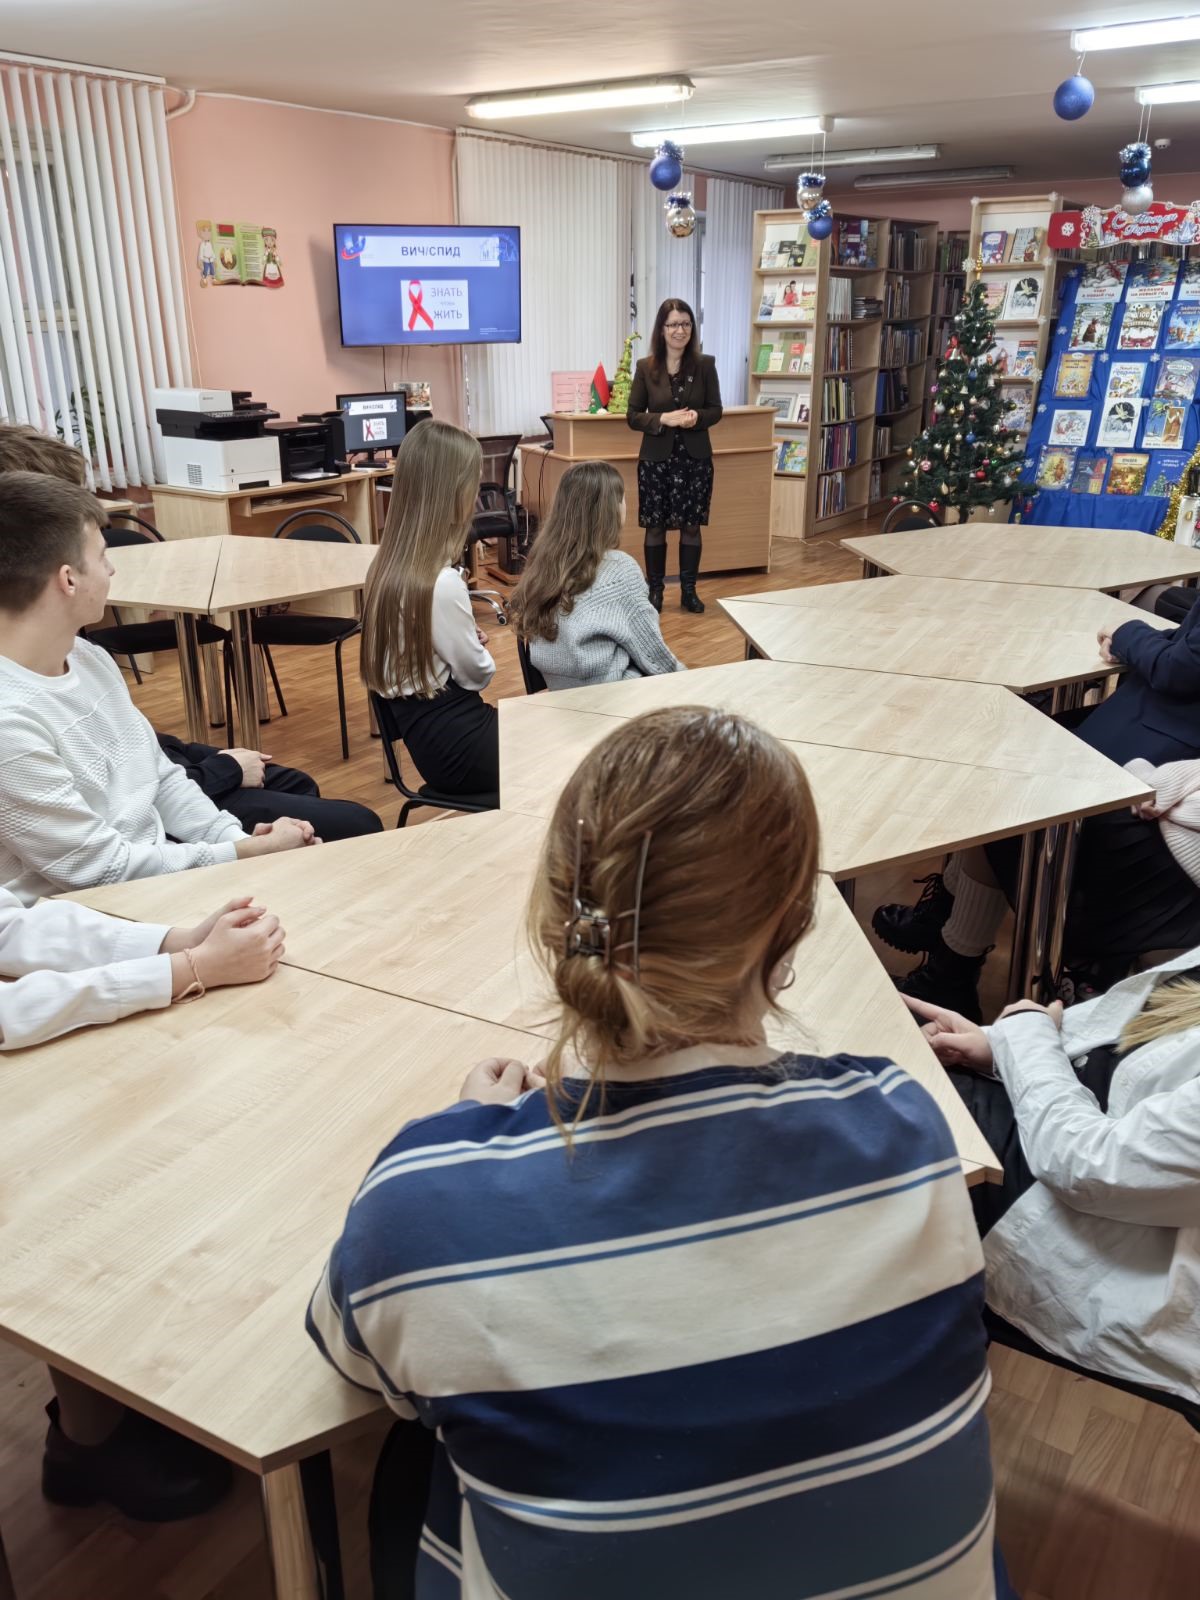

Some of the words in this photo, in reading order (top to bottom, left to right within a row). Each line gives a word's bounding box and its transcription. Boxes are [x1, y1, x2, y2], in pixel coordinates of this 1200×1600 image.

[401, 246, 461, 258] ВИЧ/СПИД
[430, 287, 463, 297] ЗНАТЬ
[433, 309, 463, 319] ЖИТЬ
